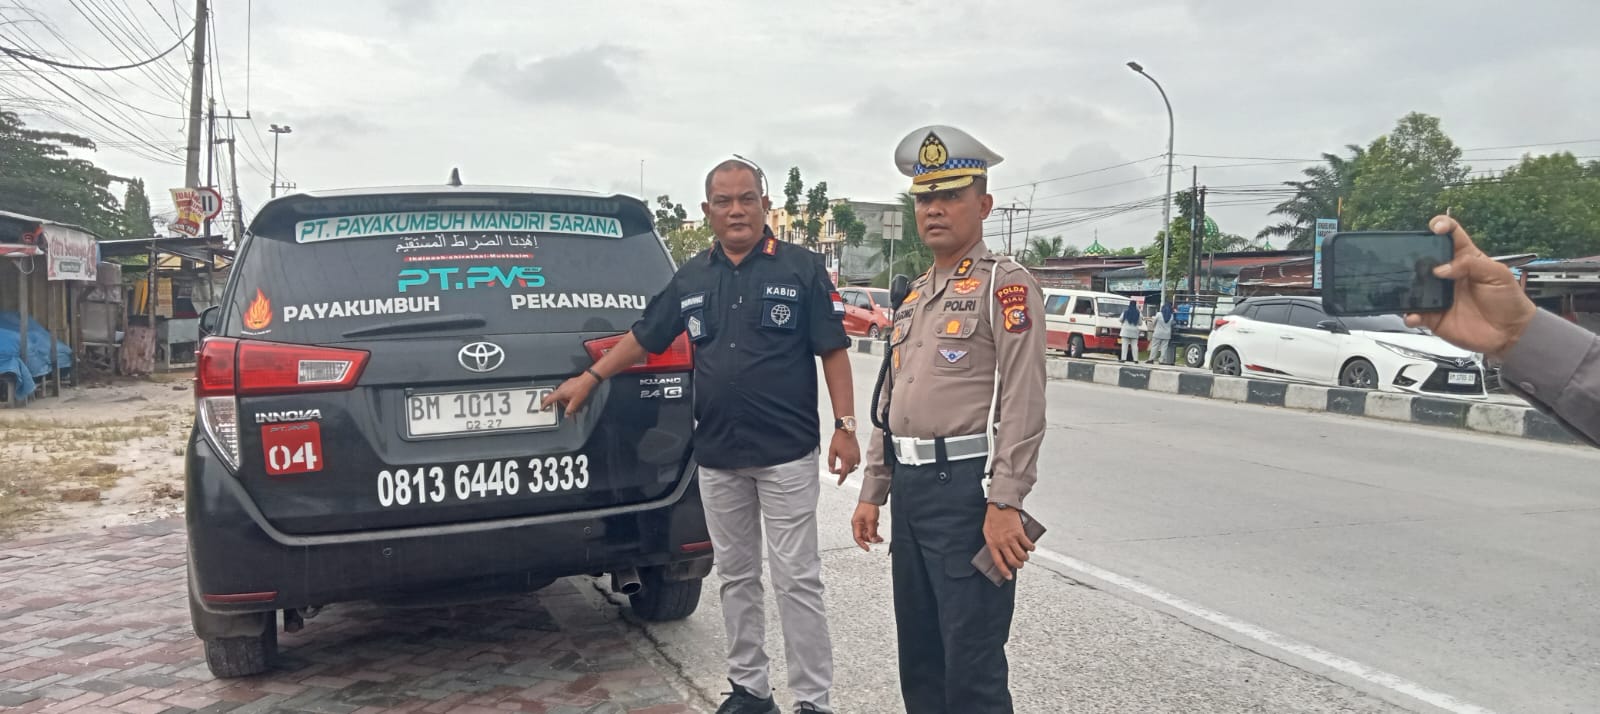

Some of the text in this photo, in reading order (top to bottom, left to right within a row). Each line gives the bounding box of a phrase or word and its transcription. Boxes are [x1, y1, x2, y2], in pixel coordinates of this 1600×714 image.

[300, 212, 620, 241] PT. PAYAKUMBUH MANDIRI SARANA
[765, 286, 797, 298] KABID
[997, 286, 1025, 298] POLDA
[283, 295, 440, 321] PAYAKUMBUH
[511, 293, 646, 311] PEKANBARU
[943, 299, 977, 313] POLRI
[1002, 296, 1024, 305] RIAU
[665, 387, 681, 398] G
[411, 395, 441, 421] BM
[453, 390, 512, 418] 1013
[255, 408, 323, 423] INNOVA
[268, 441, 318, 471] 04
[378, 453, 590, 508] 0813 6446 3333
